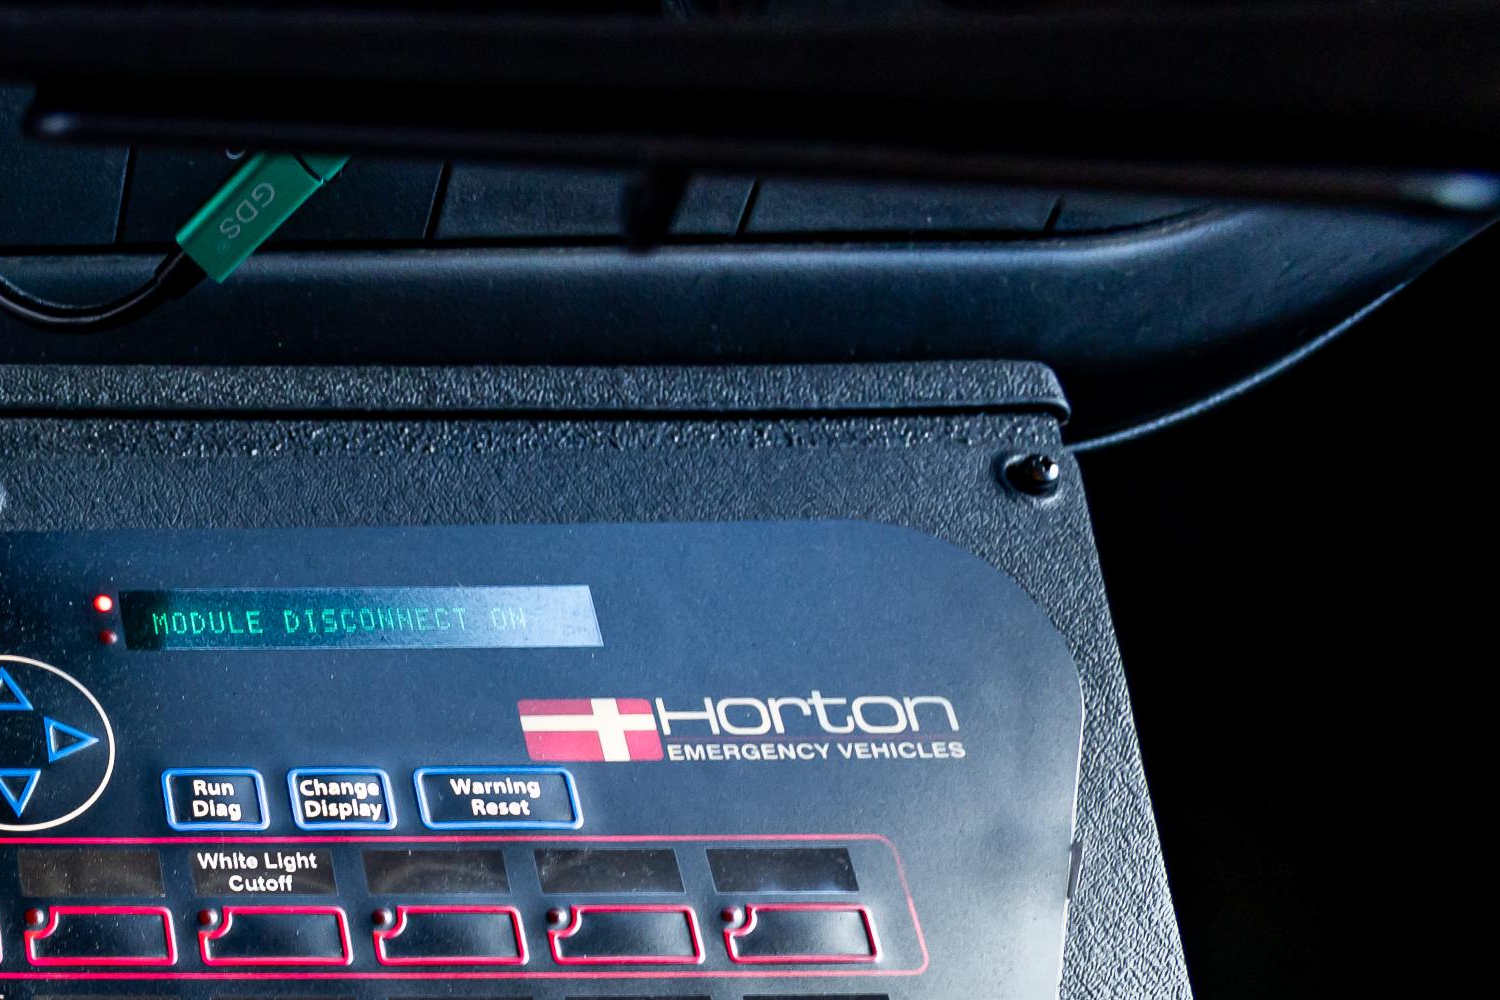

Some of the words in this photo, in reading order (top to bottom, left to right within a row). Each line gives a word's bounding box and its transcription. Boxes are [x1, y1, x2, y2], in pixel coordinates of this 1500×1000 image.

[219, 182, 276, 240] GDS
[152, 609, 264, 635] MODULE
[284, 607, 468, 634] DISCONNECT
[490, 607, 526, 631] ON
[655, 690, 960, 736] Horton
[667, 741, 830, 762] EMERGENCY
[837, 740, 967, 760] VEHICLES
[192, 779, 235, 797] Run
[299, 779, 380, 801] Change
[449, 778, 542, 799] Warning
[192, 800, 242, 822] Diag
[304, 800, 382, 821] Display
[471, 799, 531, 817] Reset
[197, 852, 259, 870] White
[263, 852, 318, 872] Light
[228, 874, 293, 893] Cutoff
